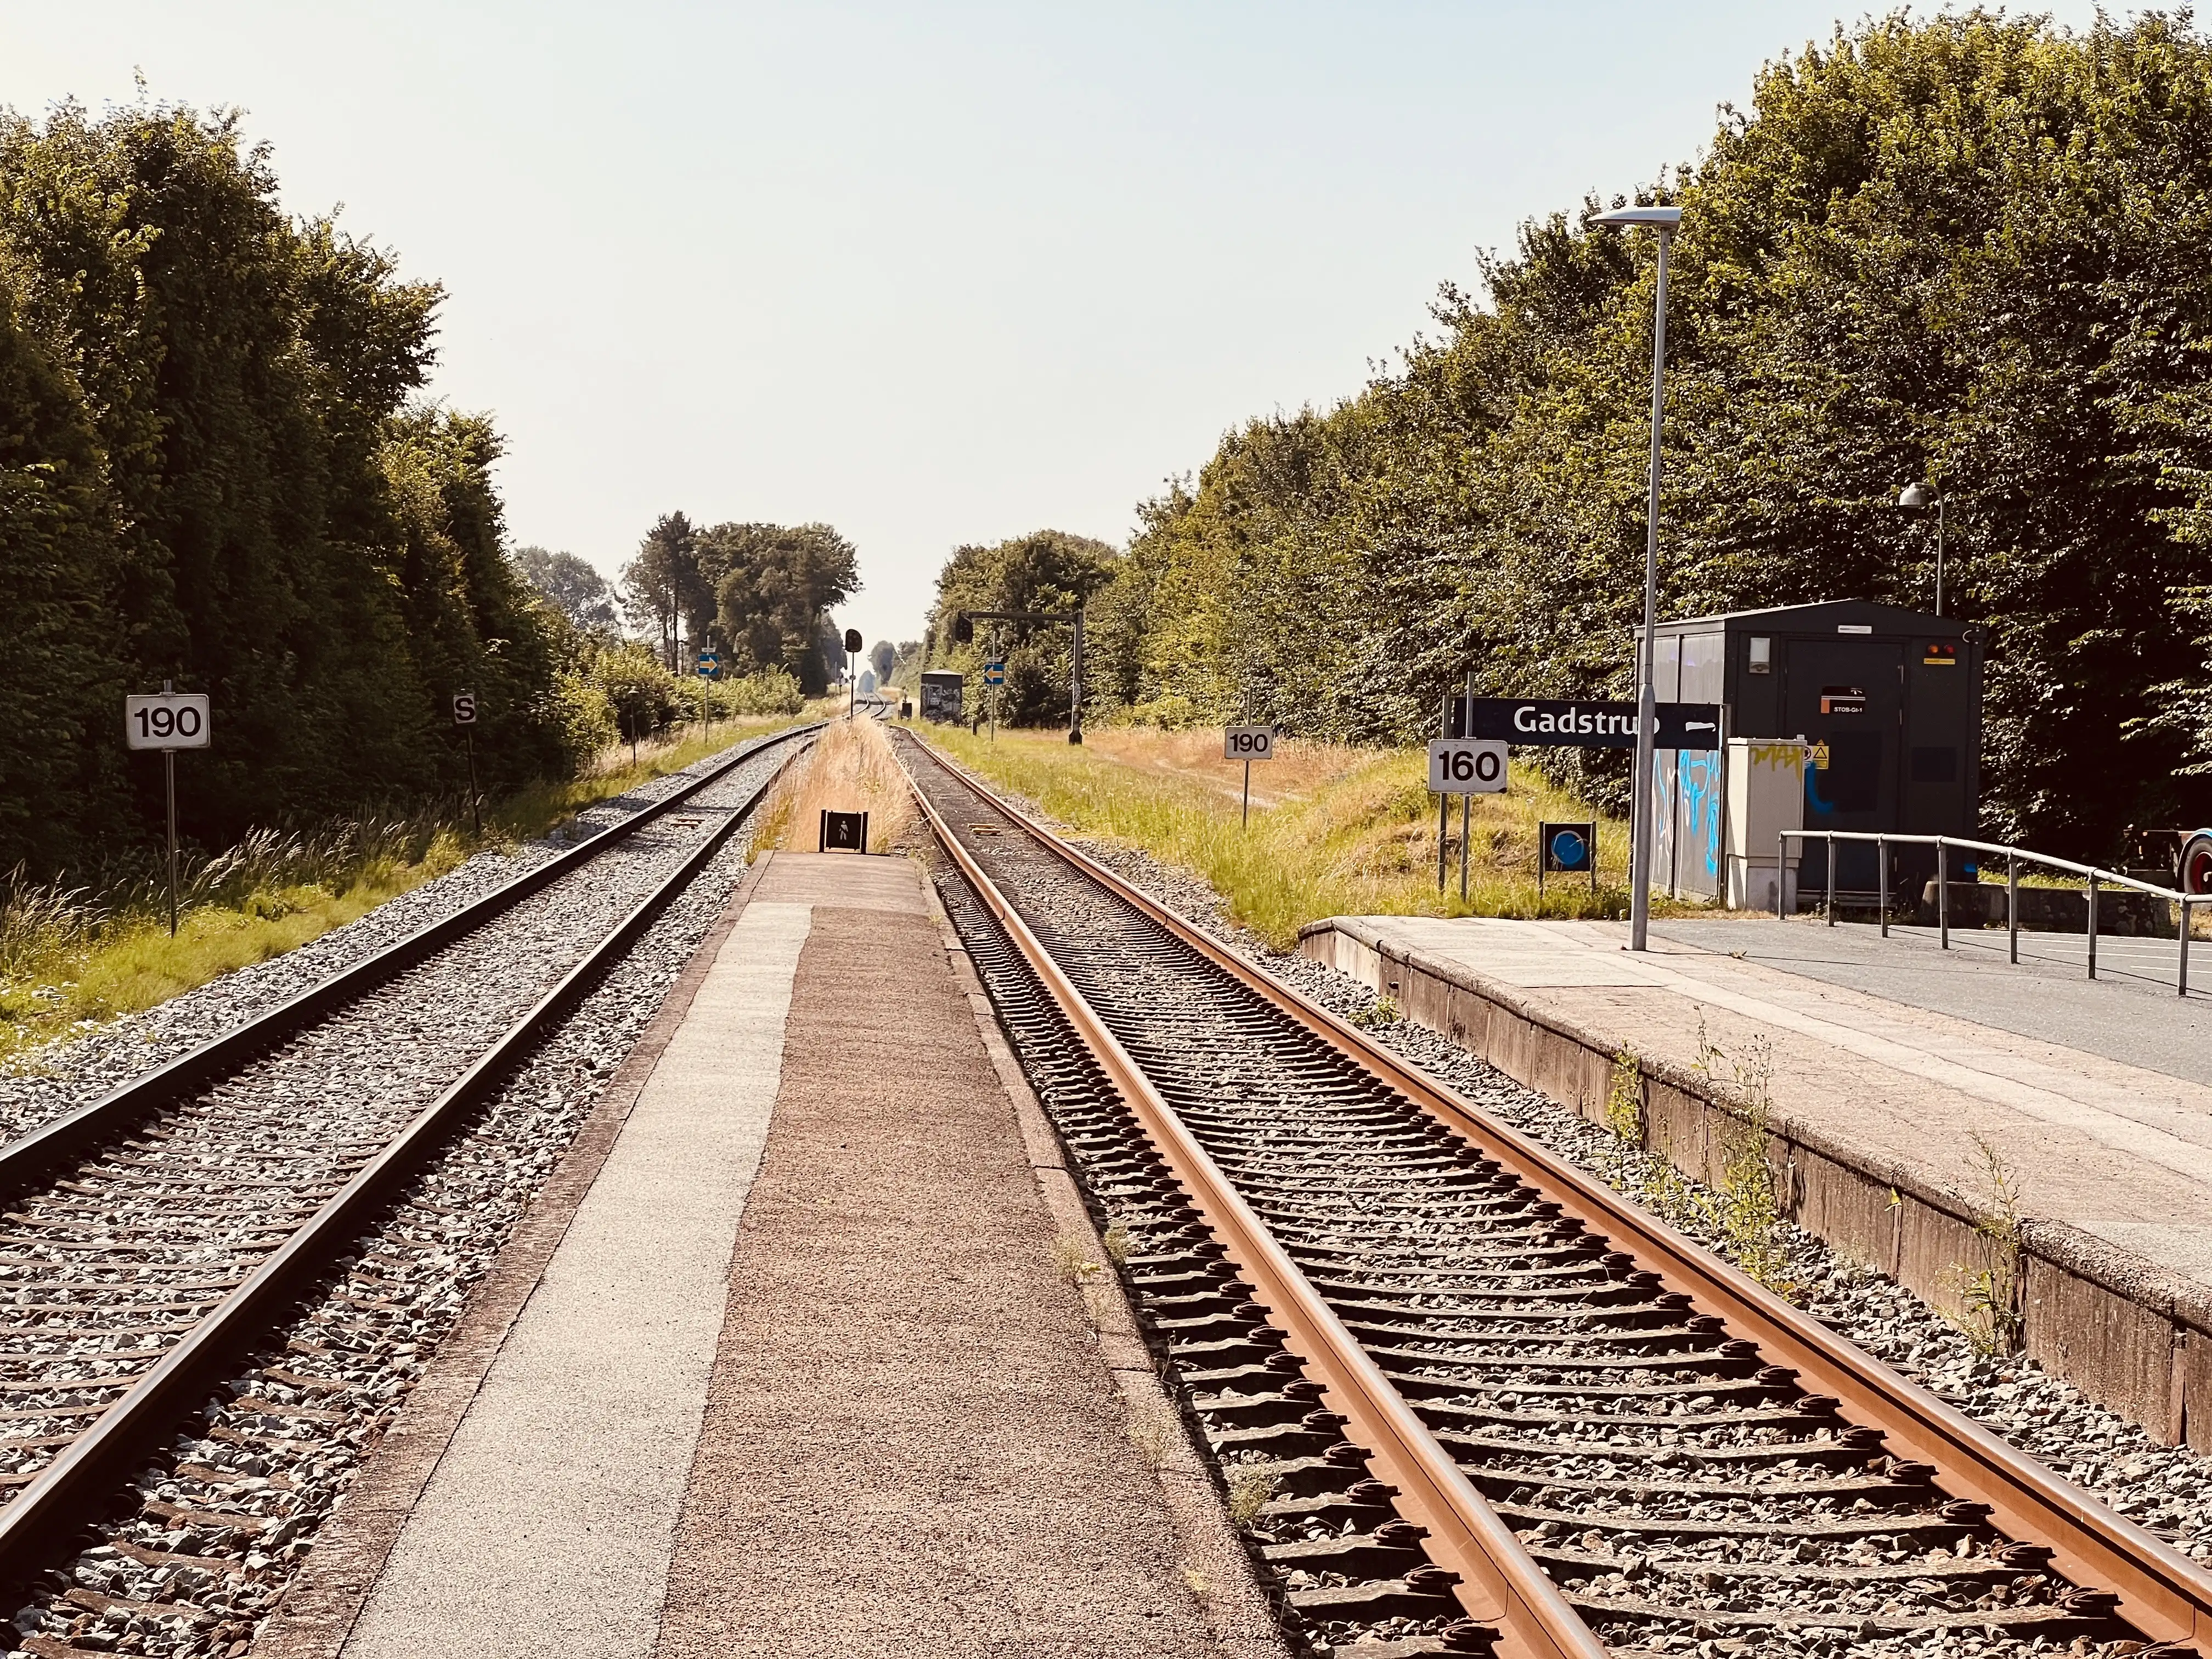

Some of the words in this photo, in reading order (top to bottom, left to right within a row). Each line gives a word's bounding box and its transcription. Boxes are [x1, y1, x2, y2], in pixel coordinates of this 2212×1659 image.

[134, 707, 201, 737] 190
[455, 697, 475, 720] S
[1514, 706, 1660, 735] Gadstru
[1229, 733, 1268, 752] 190
[1438, 751, 1500, 781] 160
